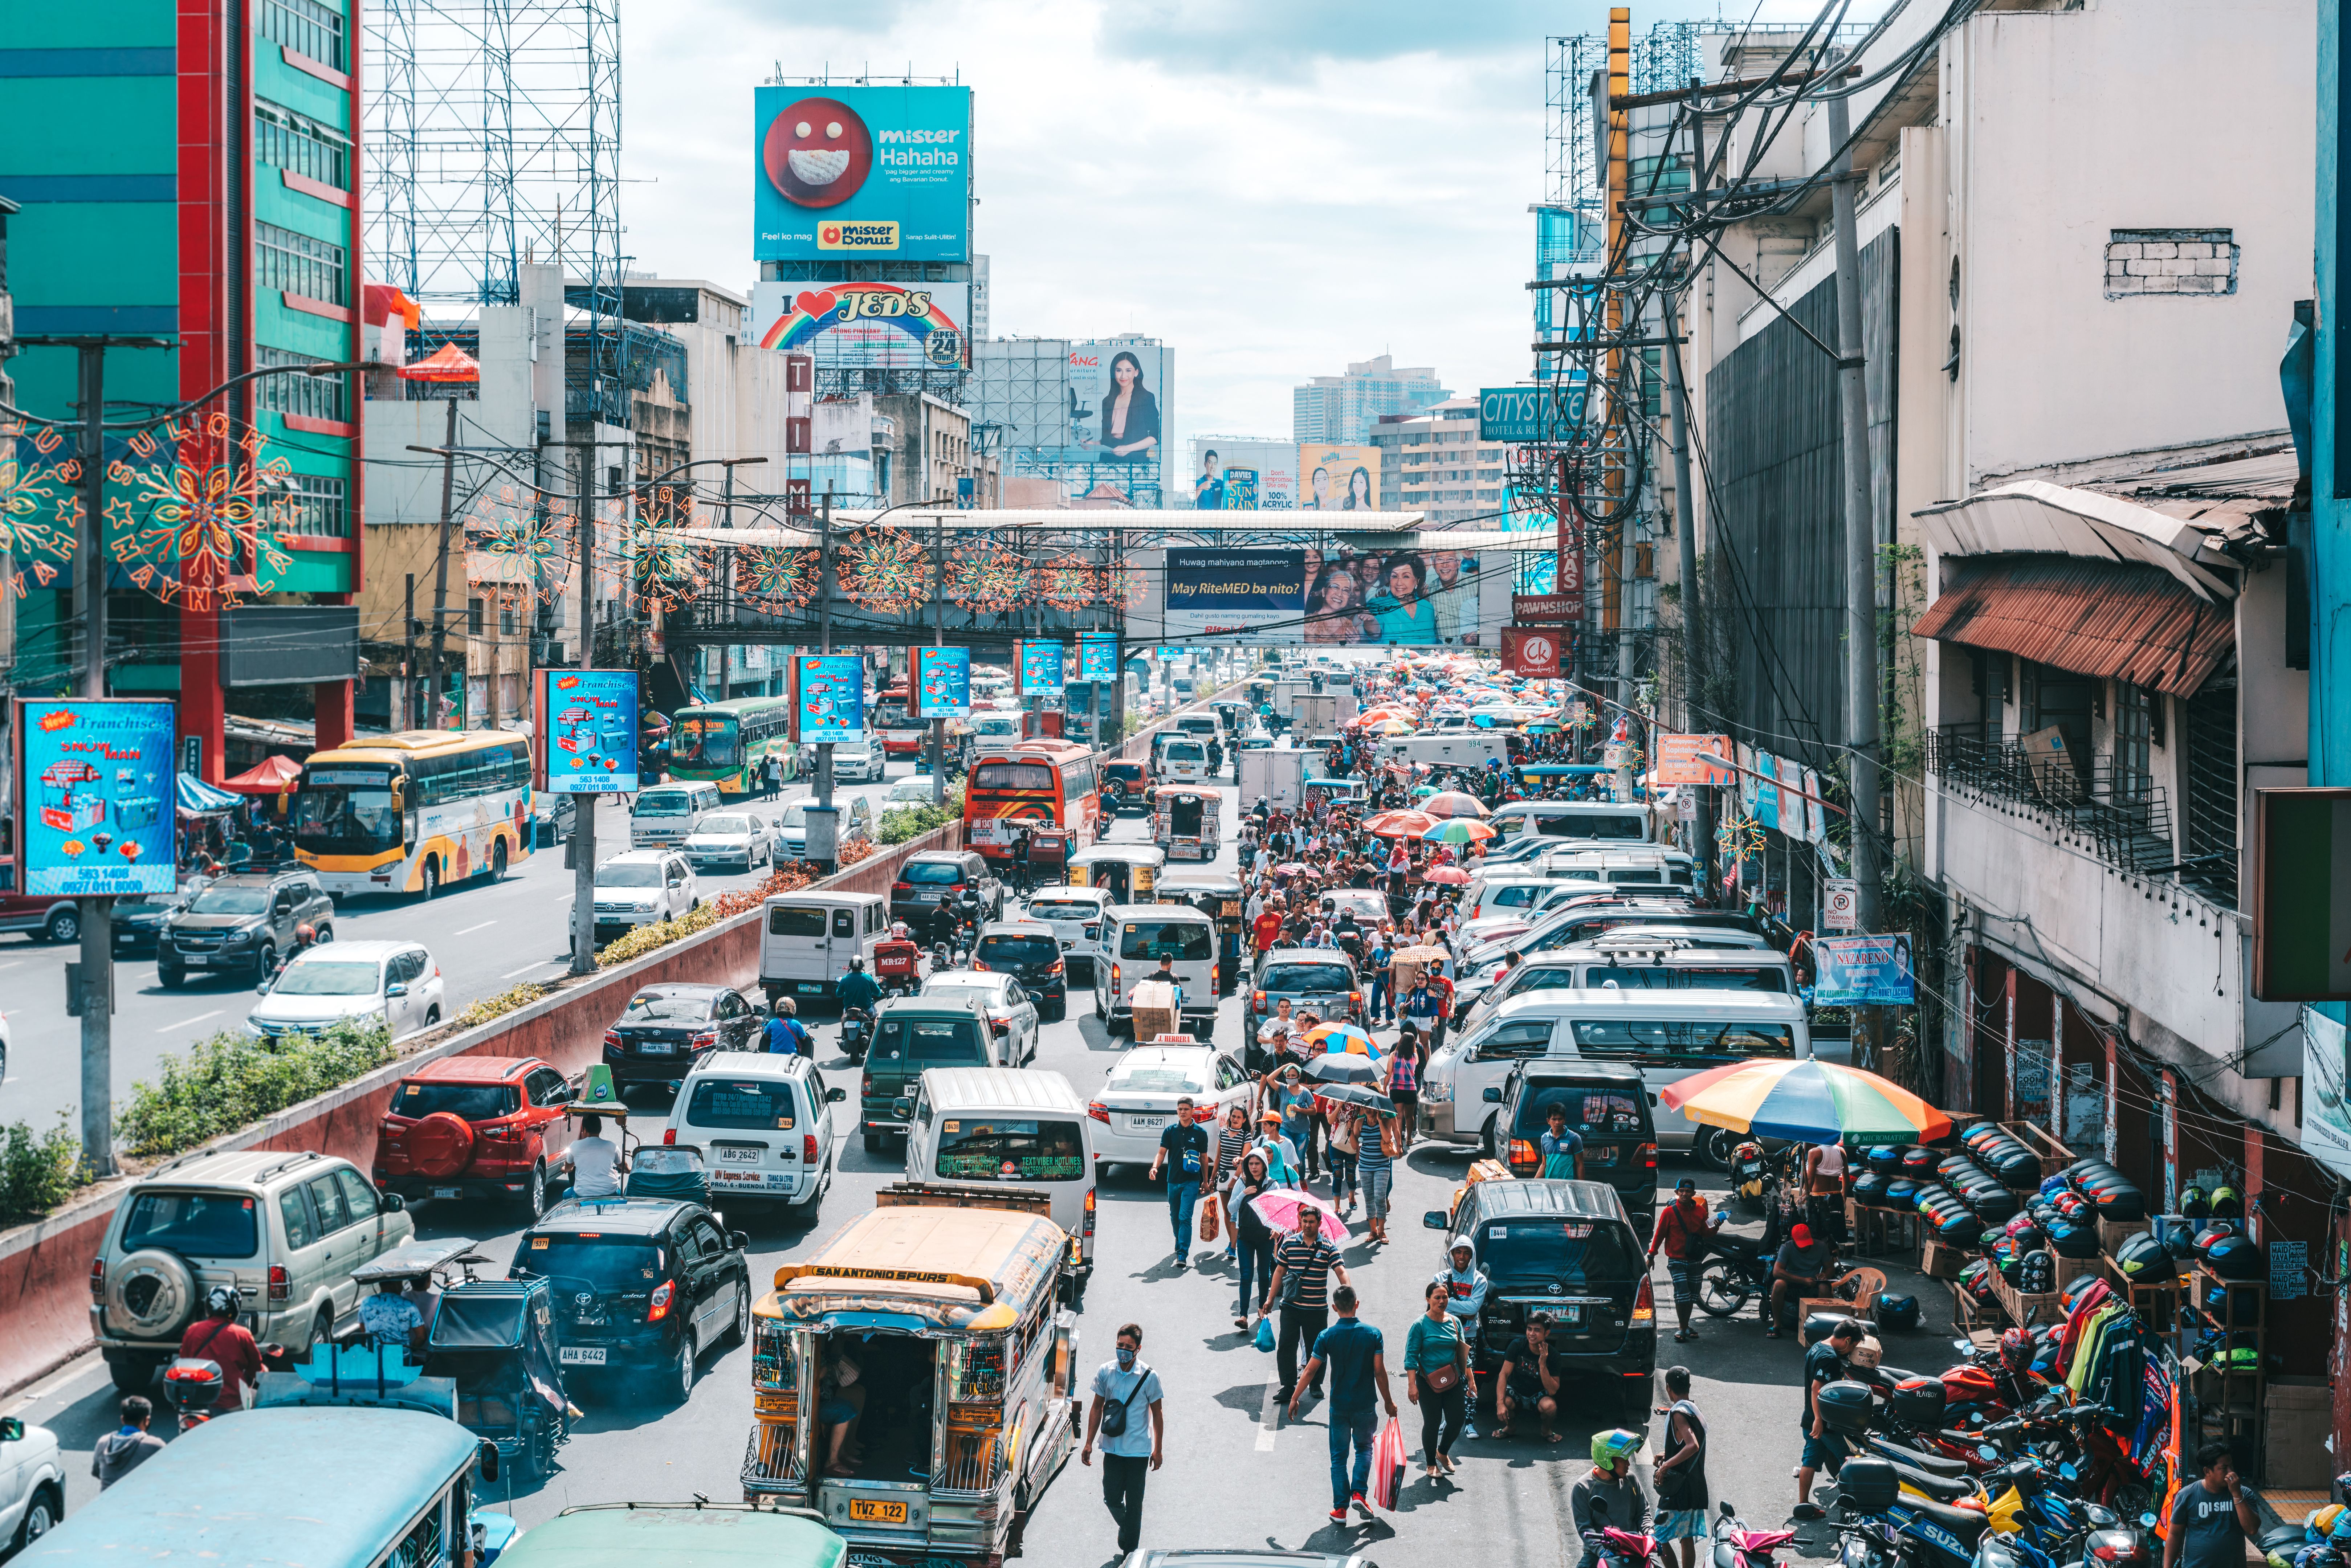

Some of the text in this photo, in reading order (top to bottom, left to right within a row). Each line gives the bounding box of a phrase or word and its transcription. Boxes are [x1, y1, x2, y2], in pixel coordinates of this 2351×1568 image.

[879, 129, 960, 143] mister
[881, 148, 958, 166] Hahaha
[843, 226, 893, 235] mister
[843, 235, 893, 245] Donut
[782, 290, 931, 322] I JED'S
[932, 339, 957, 354] 24
[1172, 583, 1300, 596] May RiteMED ba nito?
[1515, 601, 1582, 614] PAWNSHOP
[1527, 641, 1548, 660] Ck
[561, 678, 575, 688] New!
[1467, 740, 1482, 748] 994
[982, 819, 991, 828] 1347
[1837, 952, 1888, 964] NAZARENO
[1878, 988, 1892, 997] HONEY
[1893, 987, 1909, 997] LACUNA
[1704, 1115, 1742, 1130] MICROMATIC
[2306, 1116, 2349, 1151] AUTHORIZED DEALER
[1022, 1157, 1082, 1165] TEXT/VIBER HOTLINES:
[715, 1170, 760, 1182] UV Express Service
[842, 1269, 895, 1279] ANTONIO
[896, 1271, 949, 1282] SPURS
[785, 1296, 973, 1327] WELCOME
[1558, 1307, 1575, 1316] 747
[563, 1349, 603, 1360] AHA 6442
[782, 1372, 790, 1383] 23
[856, 1502, 901, 1517] TWZ 122
[2047, 1527, 2066, 1537] SUZUKI
